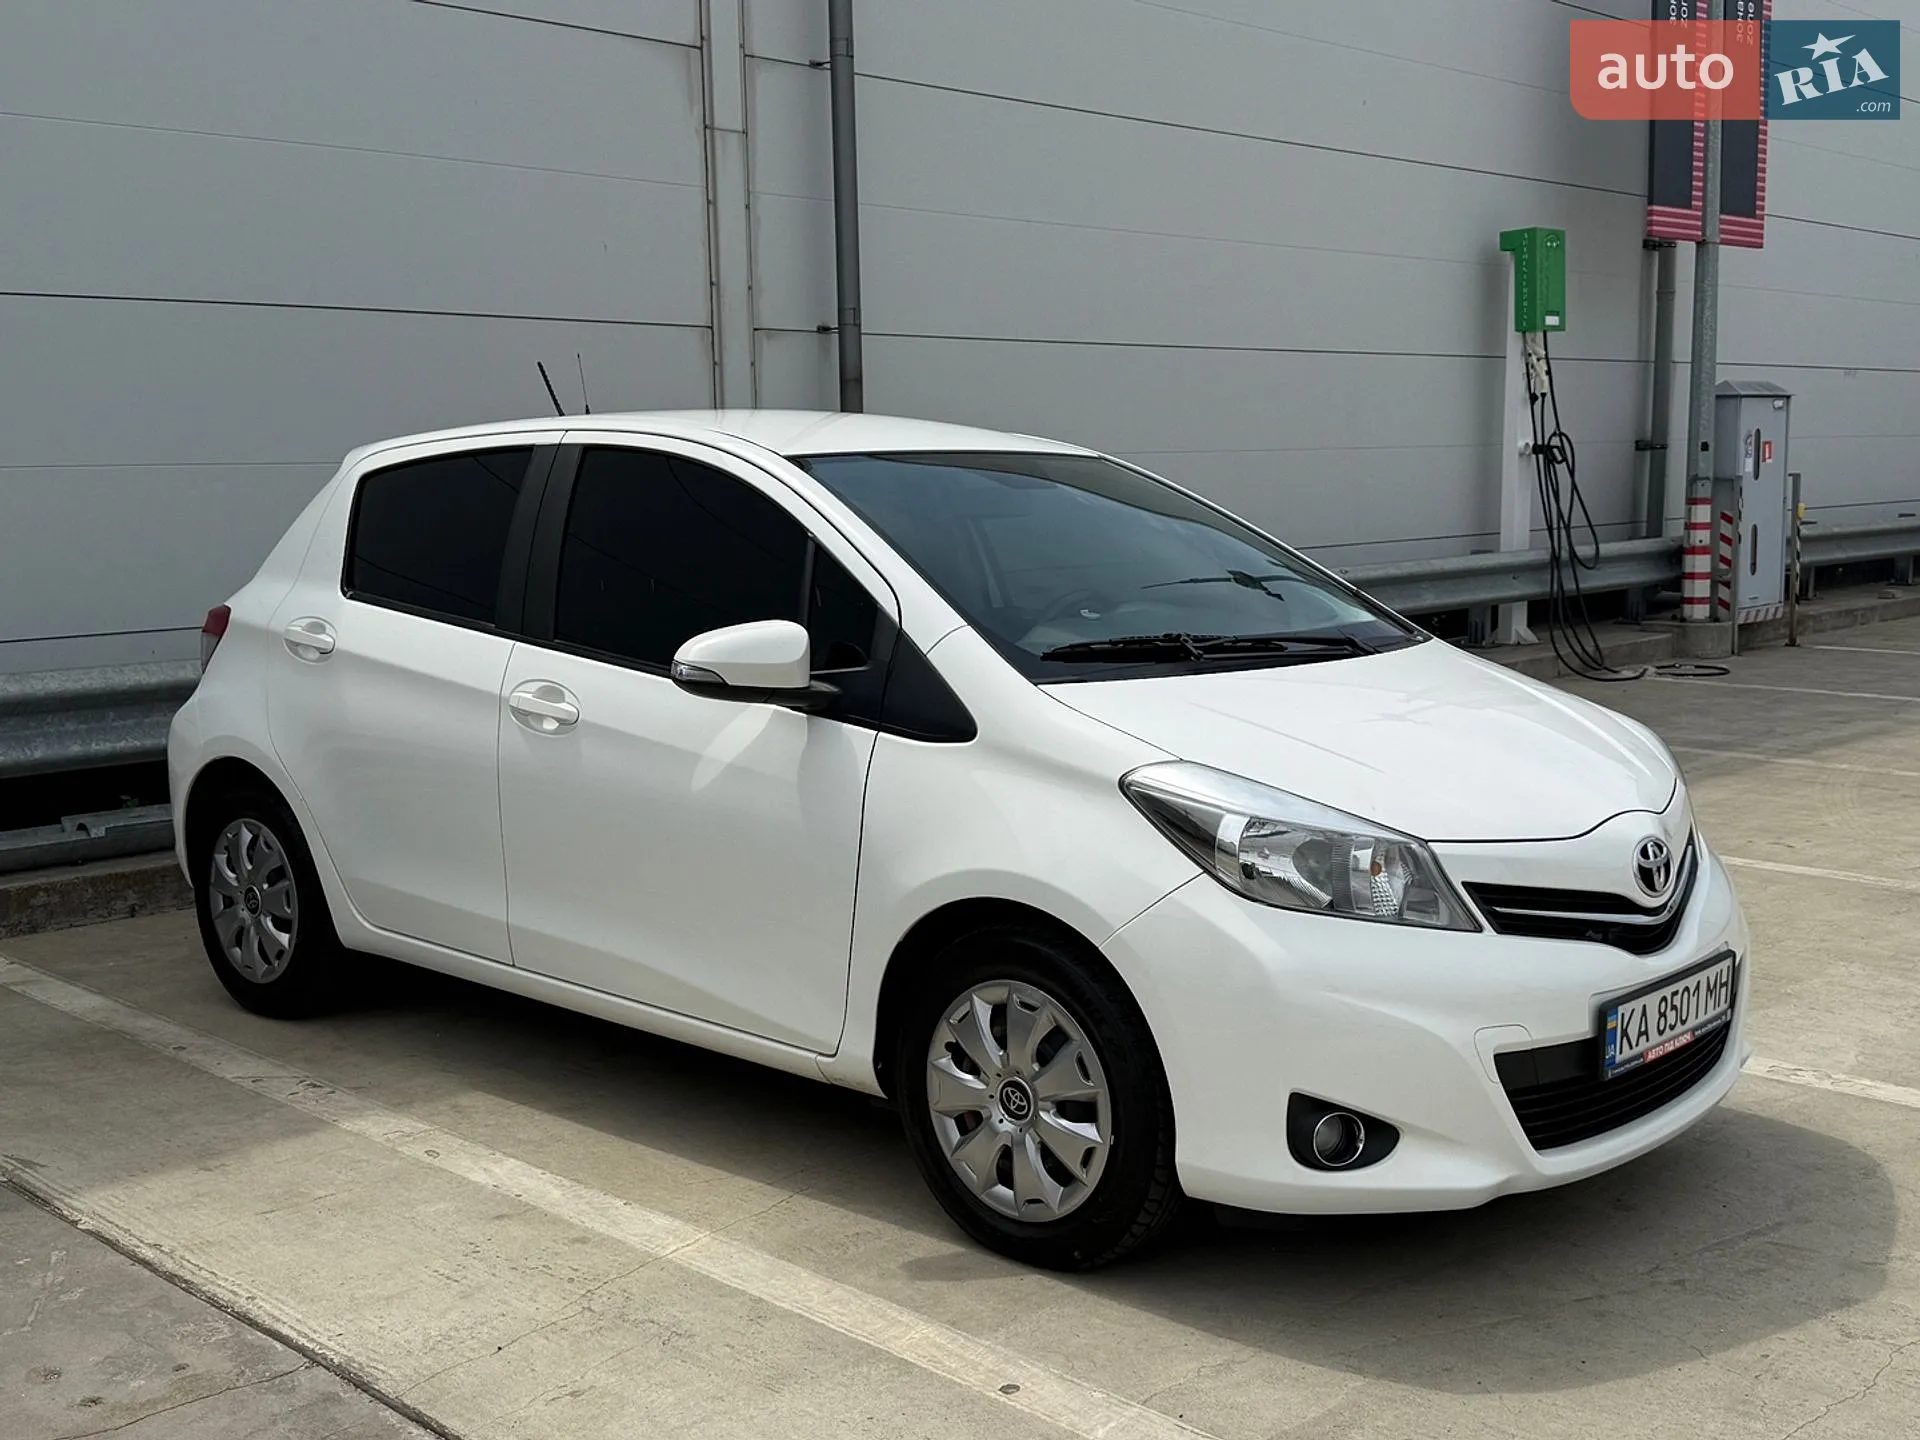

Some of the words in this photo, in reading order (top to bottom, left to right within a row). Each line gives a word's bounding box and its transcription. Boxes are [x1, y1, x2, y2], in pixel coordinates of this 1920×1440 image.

[1619, 1003, 1650, 1056] KA
[1656, 980, 1700, 1036] 8501
[1704, 965, 1731, 1015] MH
